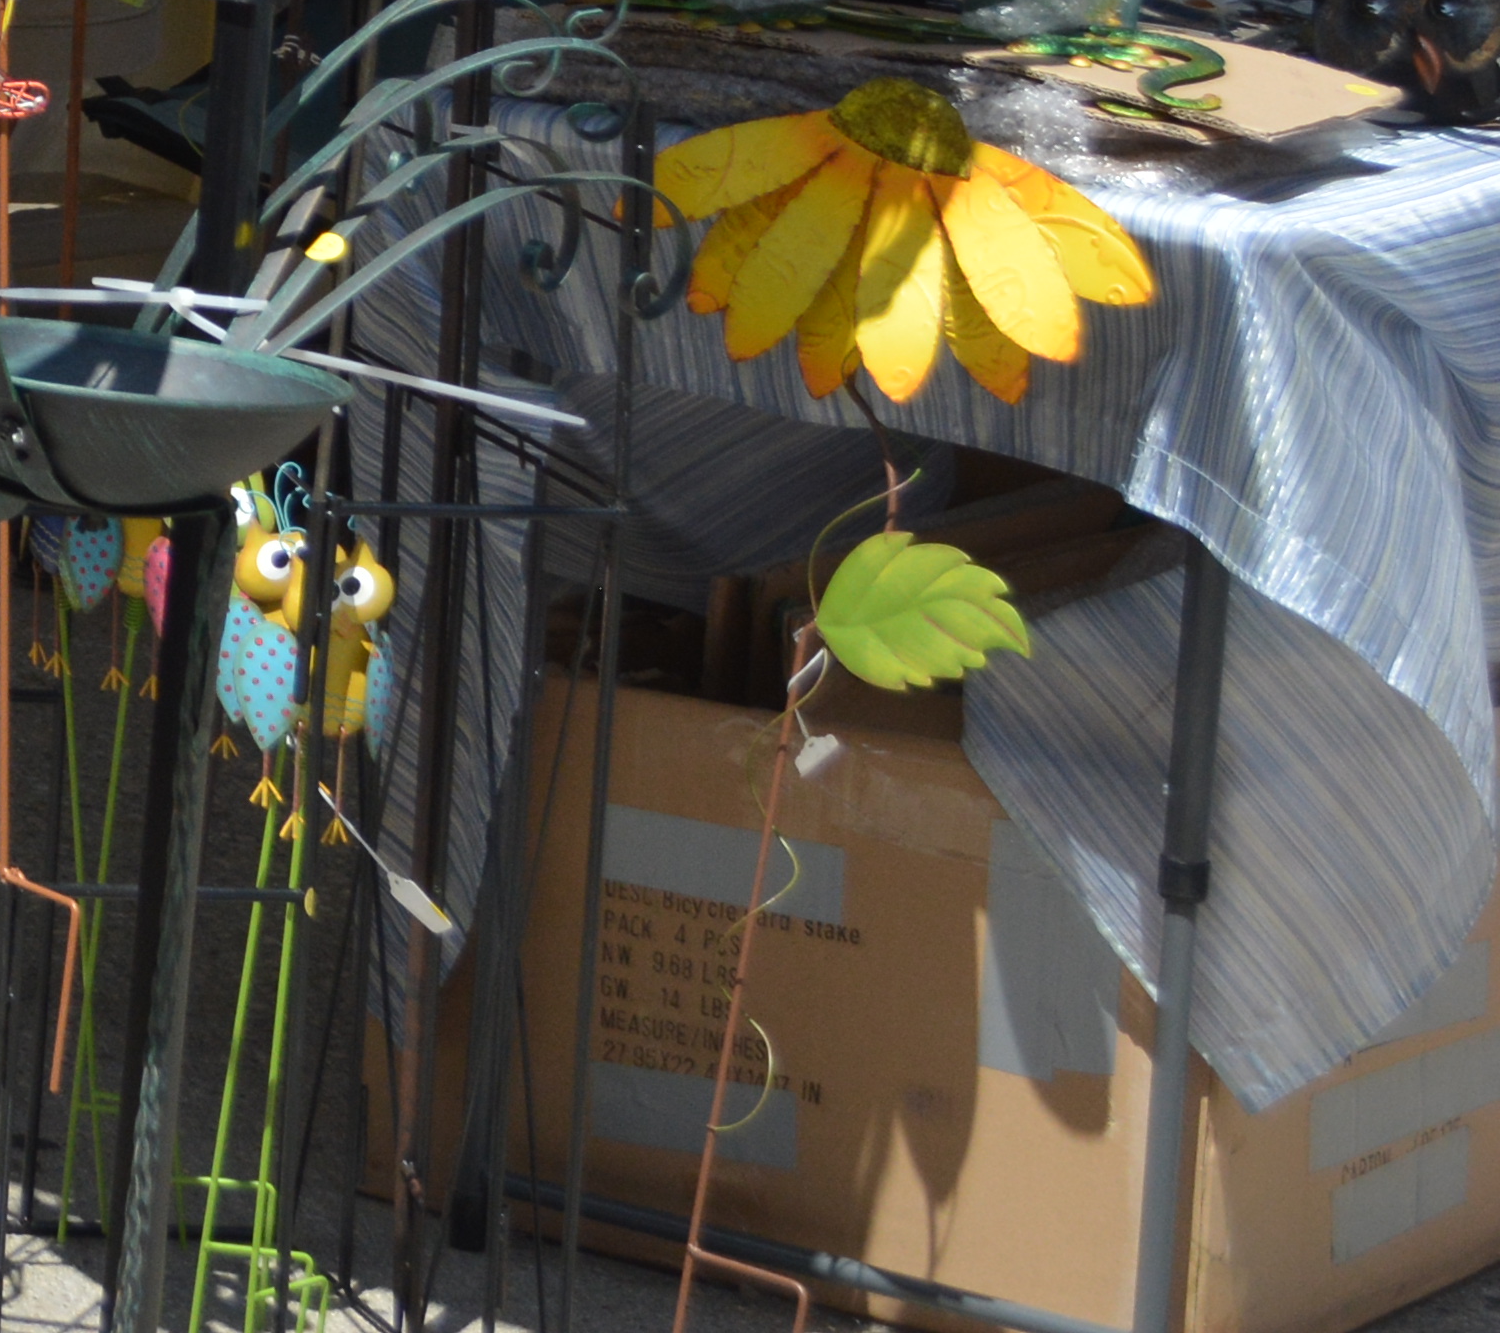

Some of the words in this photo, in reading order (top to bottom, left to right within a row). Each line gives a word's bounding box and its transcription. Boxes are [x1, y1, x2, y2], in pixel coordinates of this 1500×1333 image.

[662, 890, 737, 922] Bicycle
[745, 909, 791, 932] ard
[804, 919, 860, 945] stake
[674, 923, 686, 944] 4
[661, 987, 681, 1010] 14
[600, 1006, 767, 1063] MEASURE/INHES
[802, 1080, 821, 1105] IN
